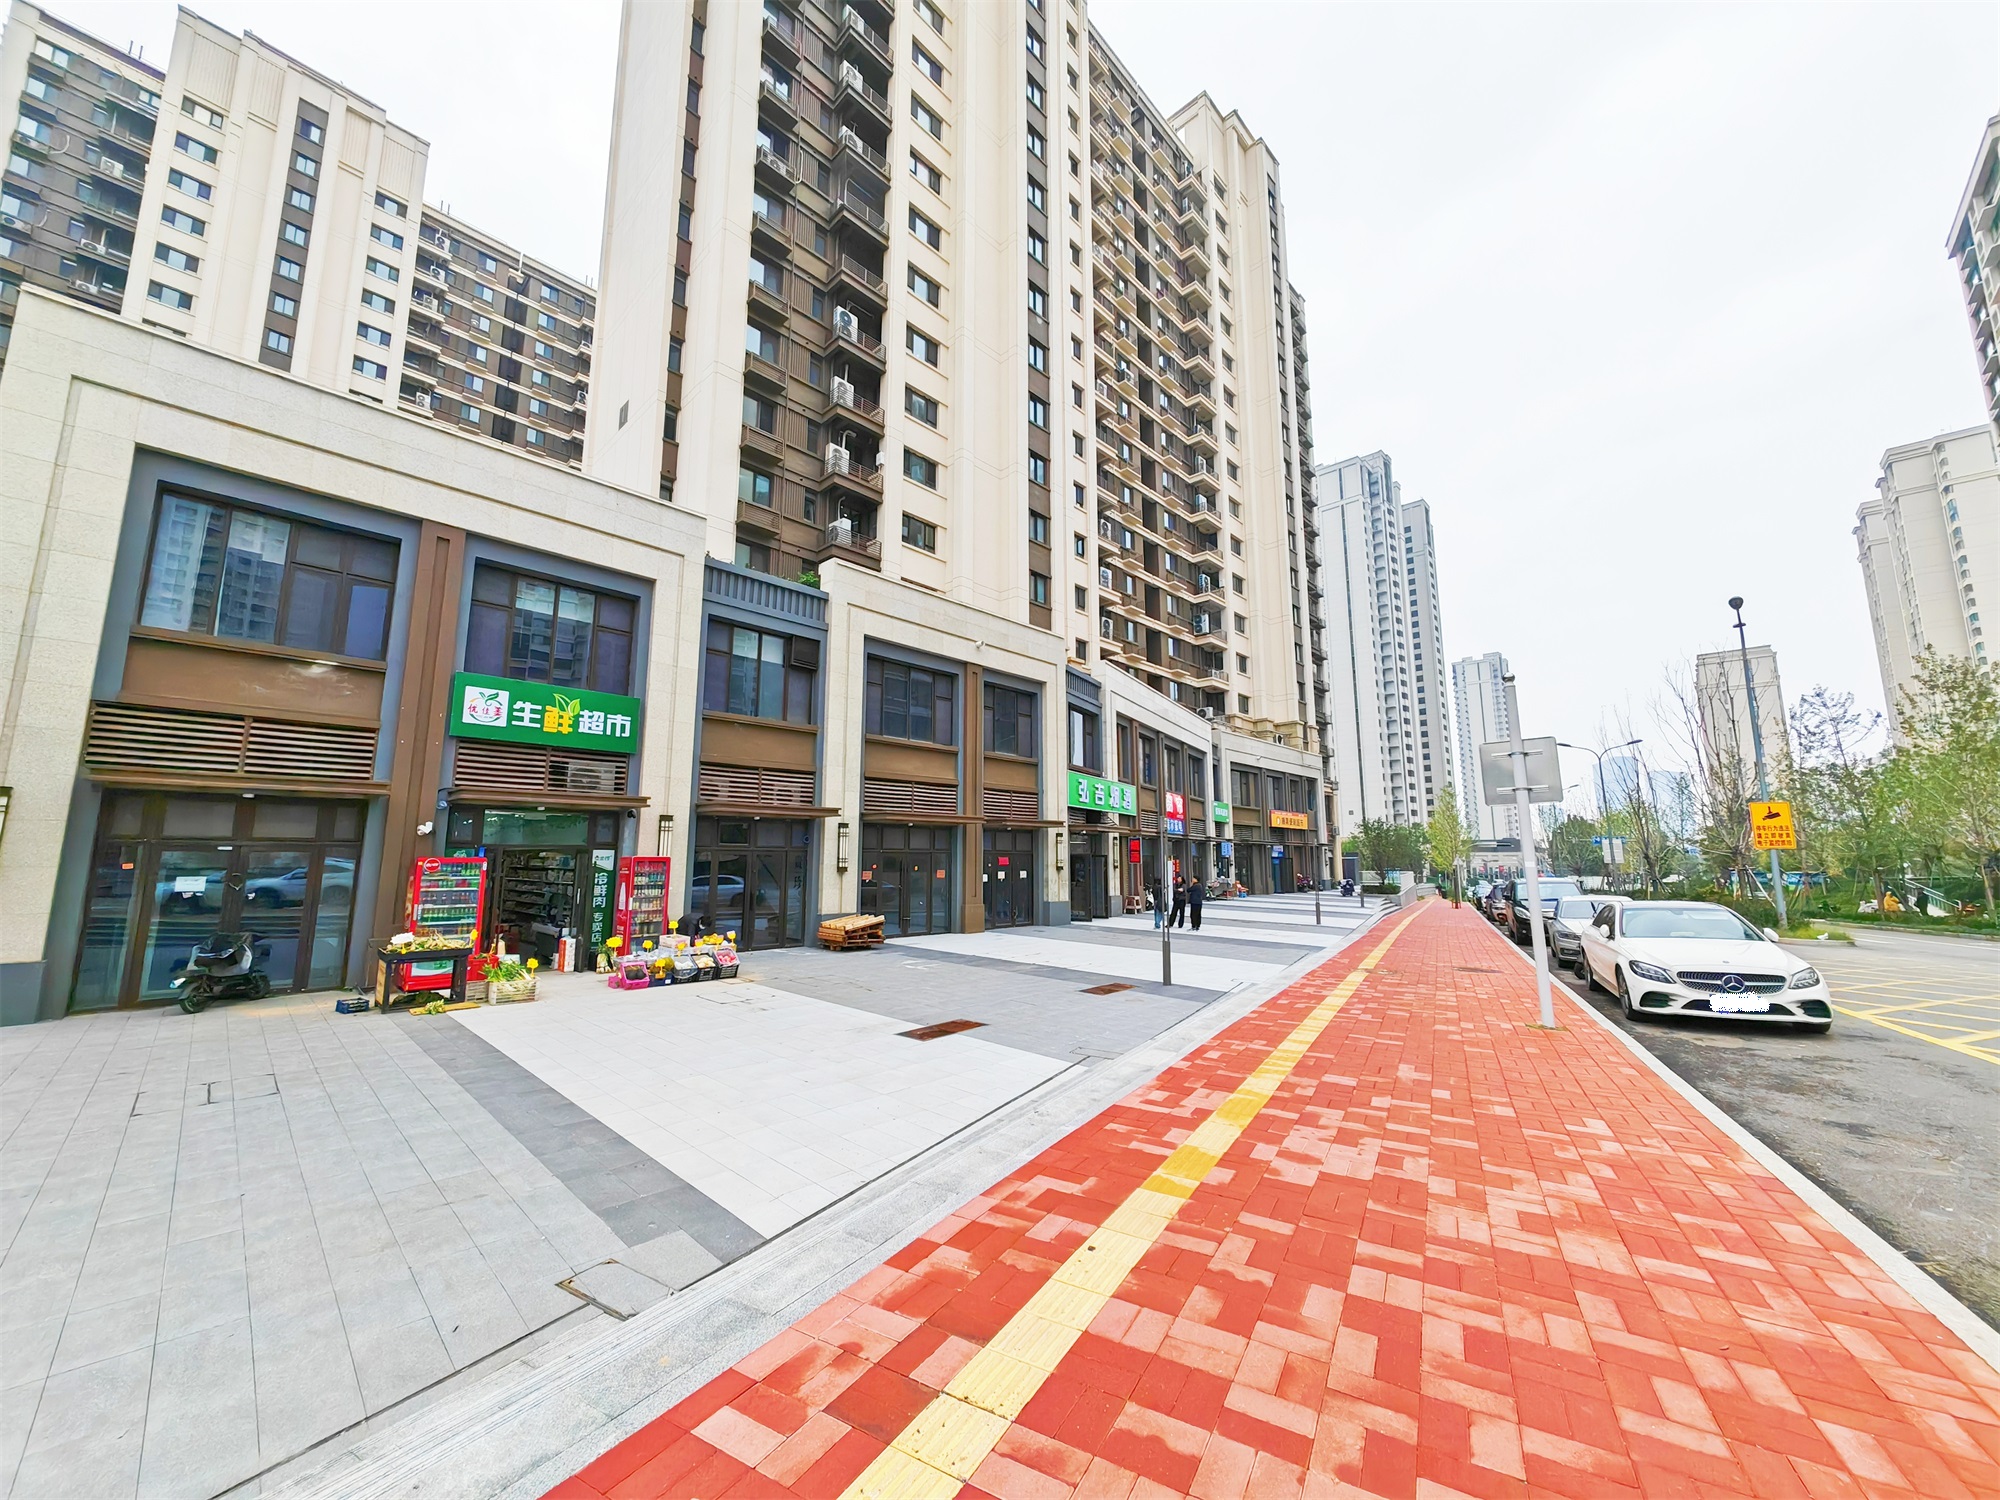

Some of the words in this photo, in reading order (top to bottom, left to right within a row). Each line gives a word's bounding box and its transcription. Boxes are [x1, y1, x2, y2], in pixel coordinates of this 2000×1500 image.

[511, 700, 632, 738] 生鲜超市
[592, 872, 608, 908] 冷鲜肉
[591, 912, 604, 943] 专卖店
